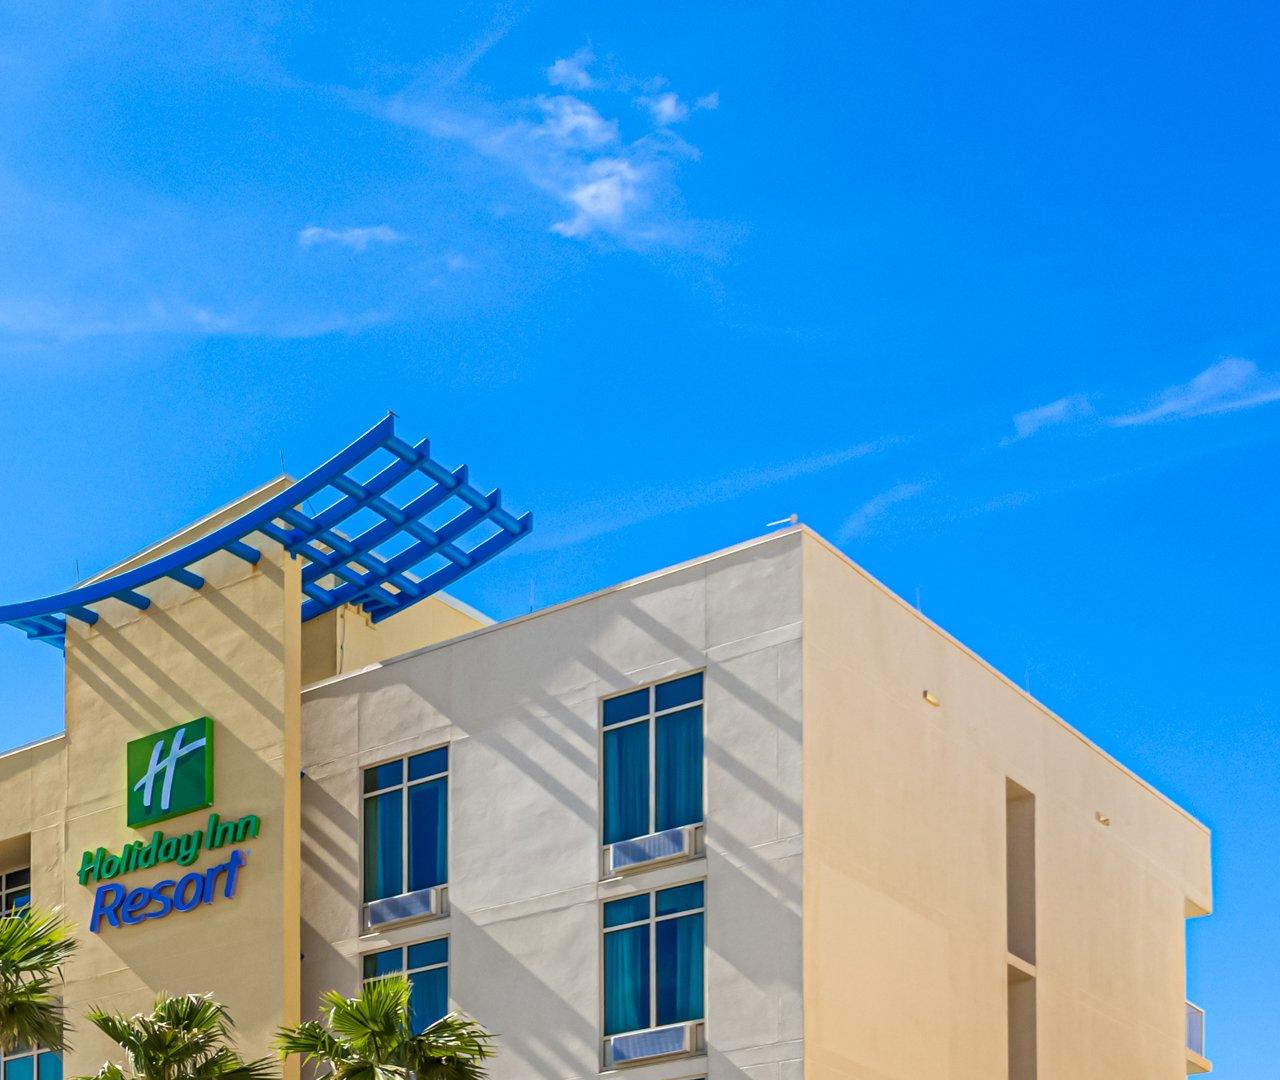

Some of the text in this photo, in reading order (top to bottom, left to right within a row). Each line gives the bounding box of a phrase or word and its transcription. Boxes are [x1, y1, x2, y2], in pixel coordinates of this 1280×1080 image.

[77, 813, 260, 885] Holiday Inn
[90, 849, 246, 933] Resort
